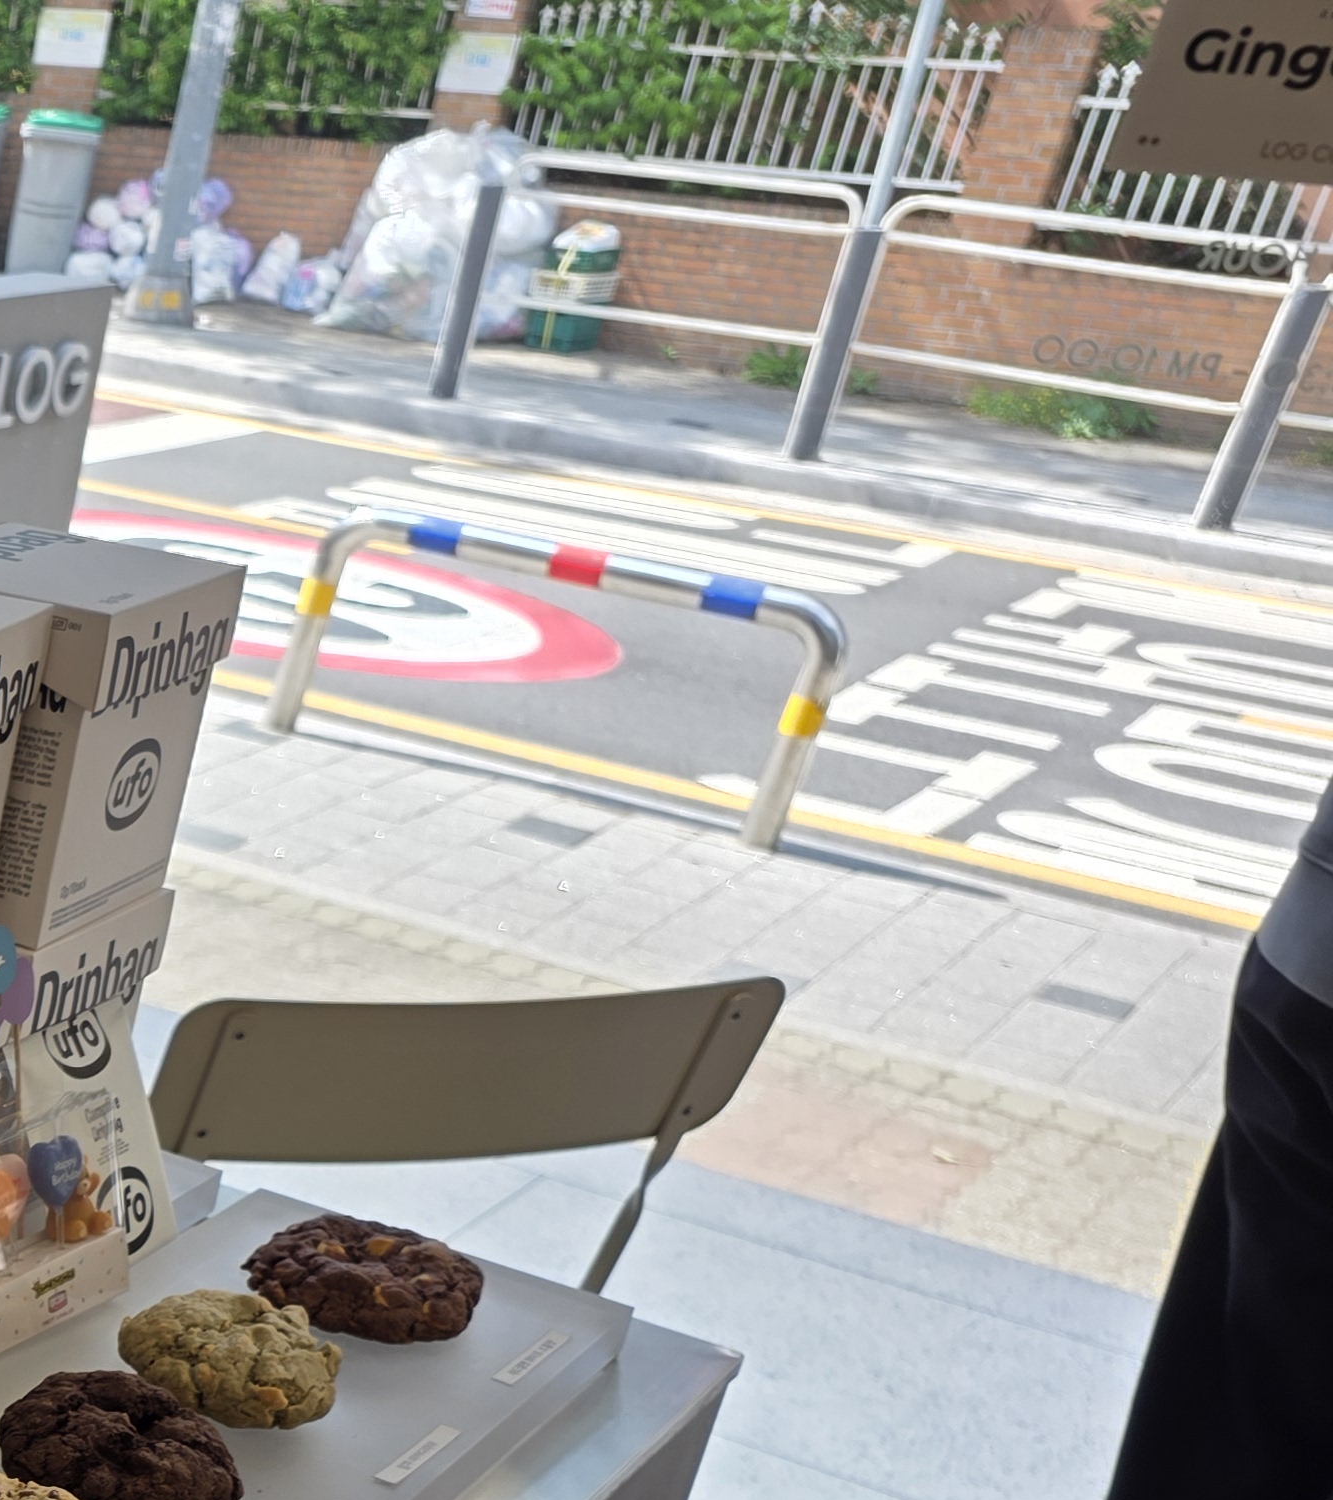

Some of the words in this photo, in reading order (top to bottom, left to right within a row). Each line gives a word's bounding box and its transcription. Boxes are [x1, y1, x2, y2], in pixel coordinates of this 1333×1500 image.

[1185, 25, 1333, 91] Ging
[112, 756, 153, 809] ufo
[52, 1017, 98, 1060] ufo
